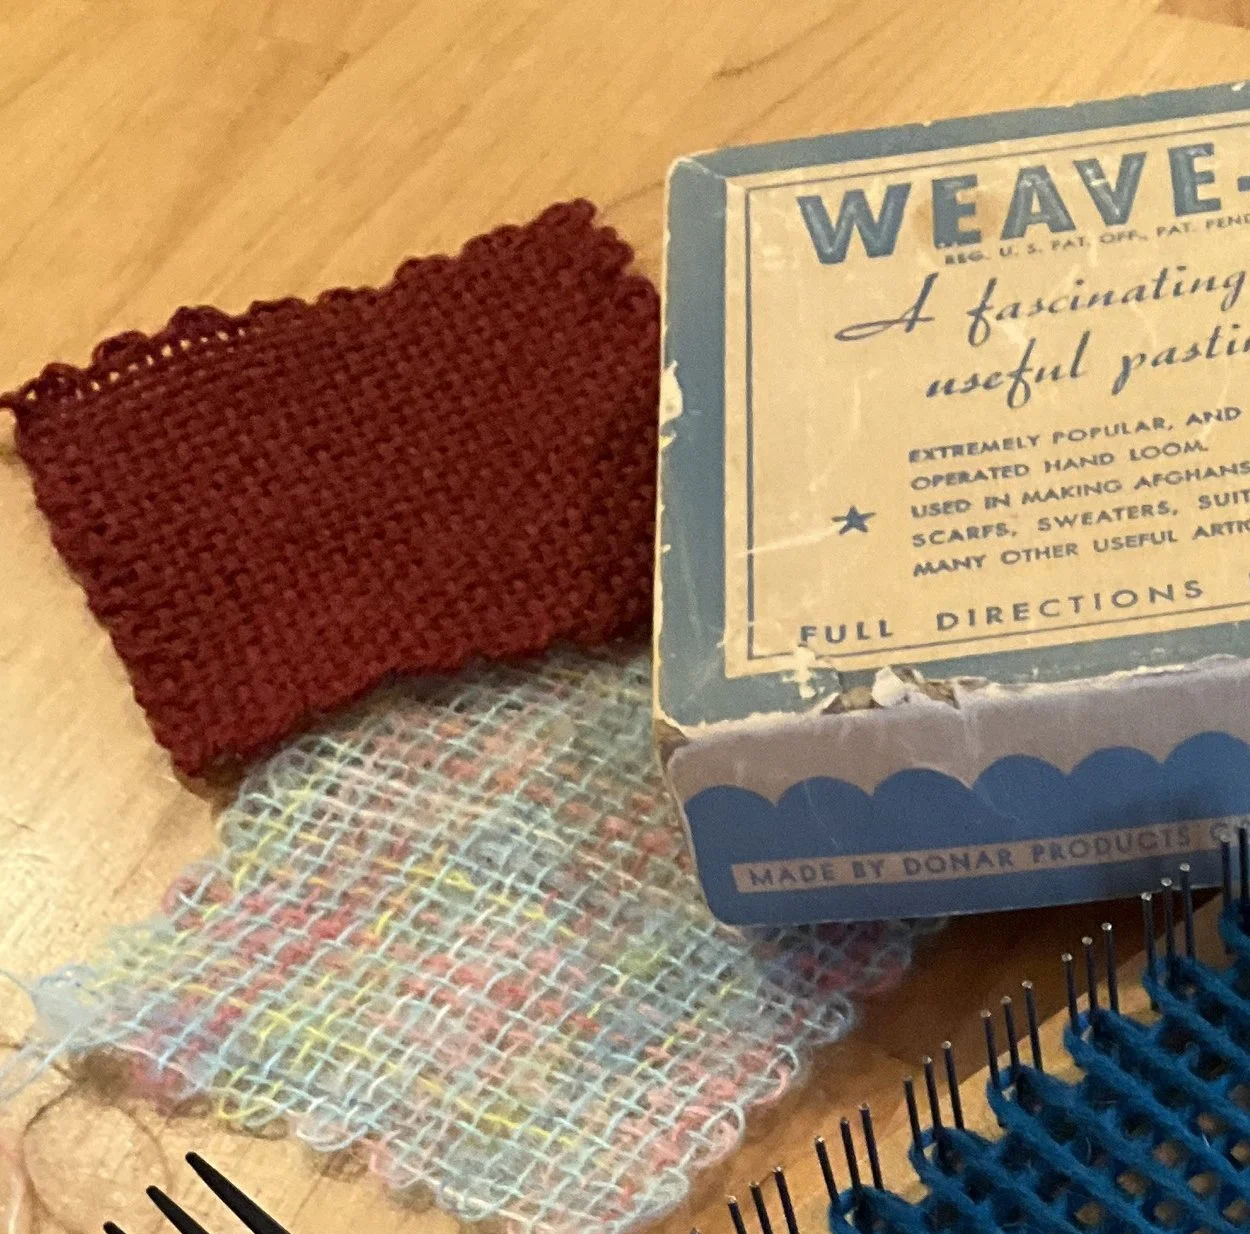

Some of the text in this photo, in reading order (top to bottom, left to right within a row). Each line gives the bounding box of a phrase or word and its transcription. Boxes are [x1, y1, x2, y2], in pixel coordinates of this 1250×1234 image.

[835, 272, 939, 341] A
[968, 265, 1246, 346] fascinating
[925, 330, 1090, 409] useful
[908, 434, 1041, 464] EXTREMELY
[1052, 417, 1174, 444] POPULAR,
[1186, 406, 1242, 426] AND
[910, 463, 1030, 491] OPERATED
[1044, 452, 1115, 474] HAND
[911, 498, 972, 519] USED
[984, 493, 1010, 511] IN
[1021, 479, 1122, 505] MAKING
[912, 522, 1018, 548] SCARFS,
[1037, 500, 1178, 532] SWEATERS,
[912, 554, 987, 578] MANY
[1000, 543, 1079, 566] OTHER
[1093, 530, 1179, 554] USEFUL
[799, 619, 894, 646] FULL
[936, 579, 1203, 630] DIRECTIONS
[747, 862, 836, 887] MADE
[852, 858, 885, 879] BY
[902, 847, 1014, 877] DONAR
[1031, 825, 1192, 864] PRODUCTS
